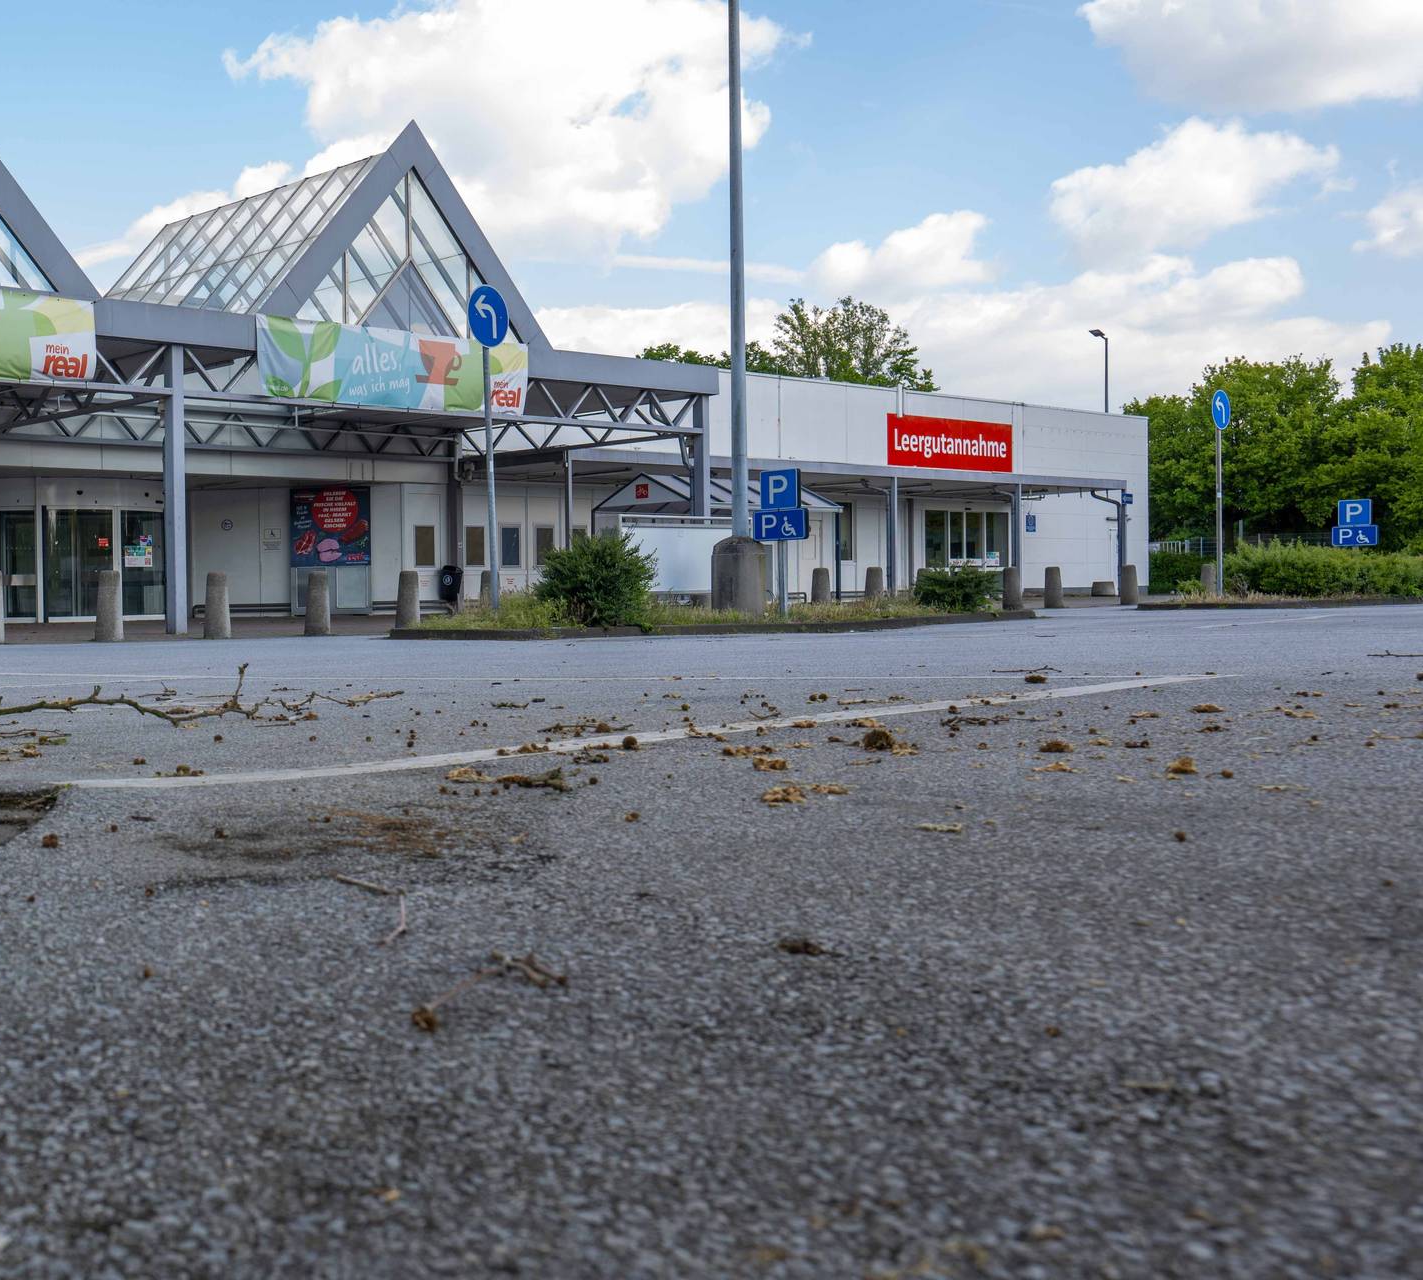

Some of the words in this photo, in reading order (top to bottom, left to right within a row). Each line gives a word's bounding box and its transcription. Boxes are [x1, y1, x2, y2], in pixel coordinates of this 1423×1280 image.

[45, 343, 70, 354] mein
[352, 342, 402, 375] alles,
[42, 353, 88, 379] real
[348, 383, 368, 397] was
[371, 375, 386, 393] ich
[389, 377, 410, 394] mag
[493, 380, 509, 389] mein
[894, 427, 1007, 458] Leergutannahme
[768, 474, 788, 505] P
[1346, 503, 1363, 523] P
[761, 514, 777, 538] P
[1339, 528, 1353, 545] P
